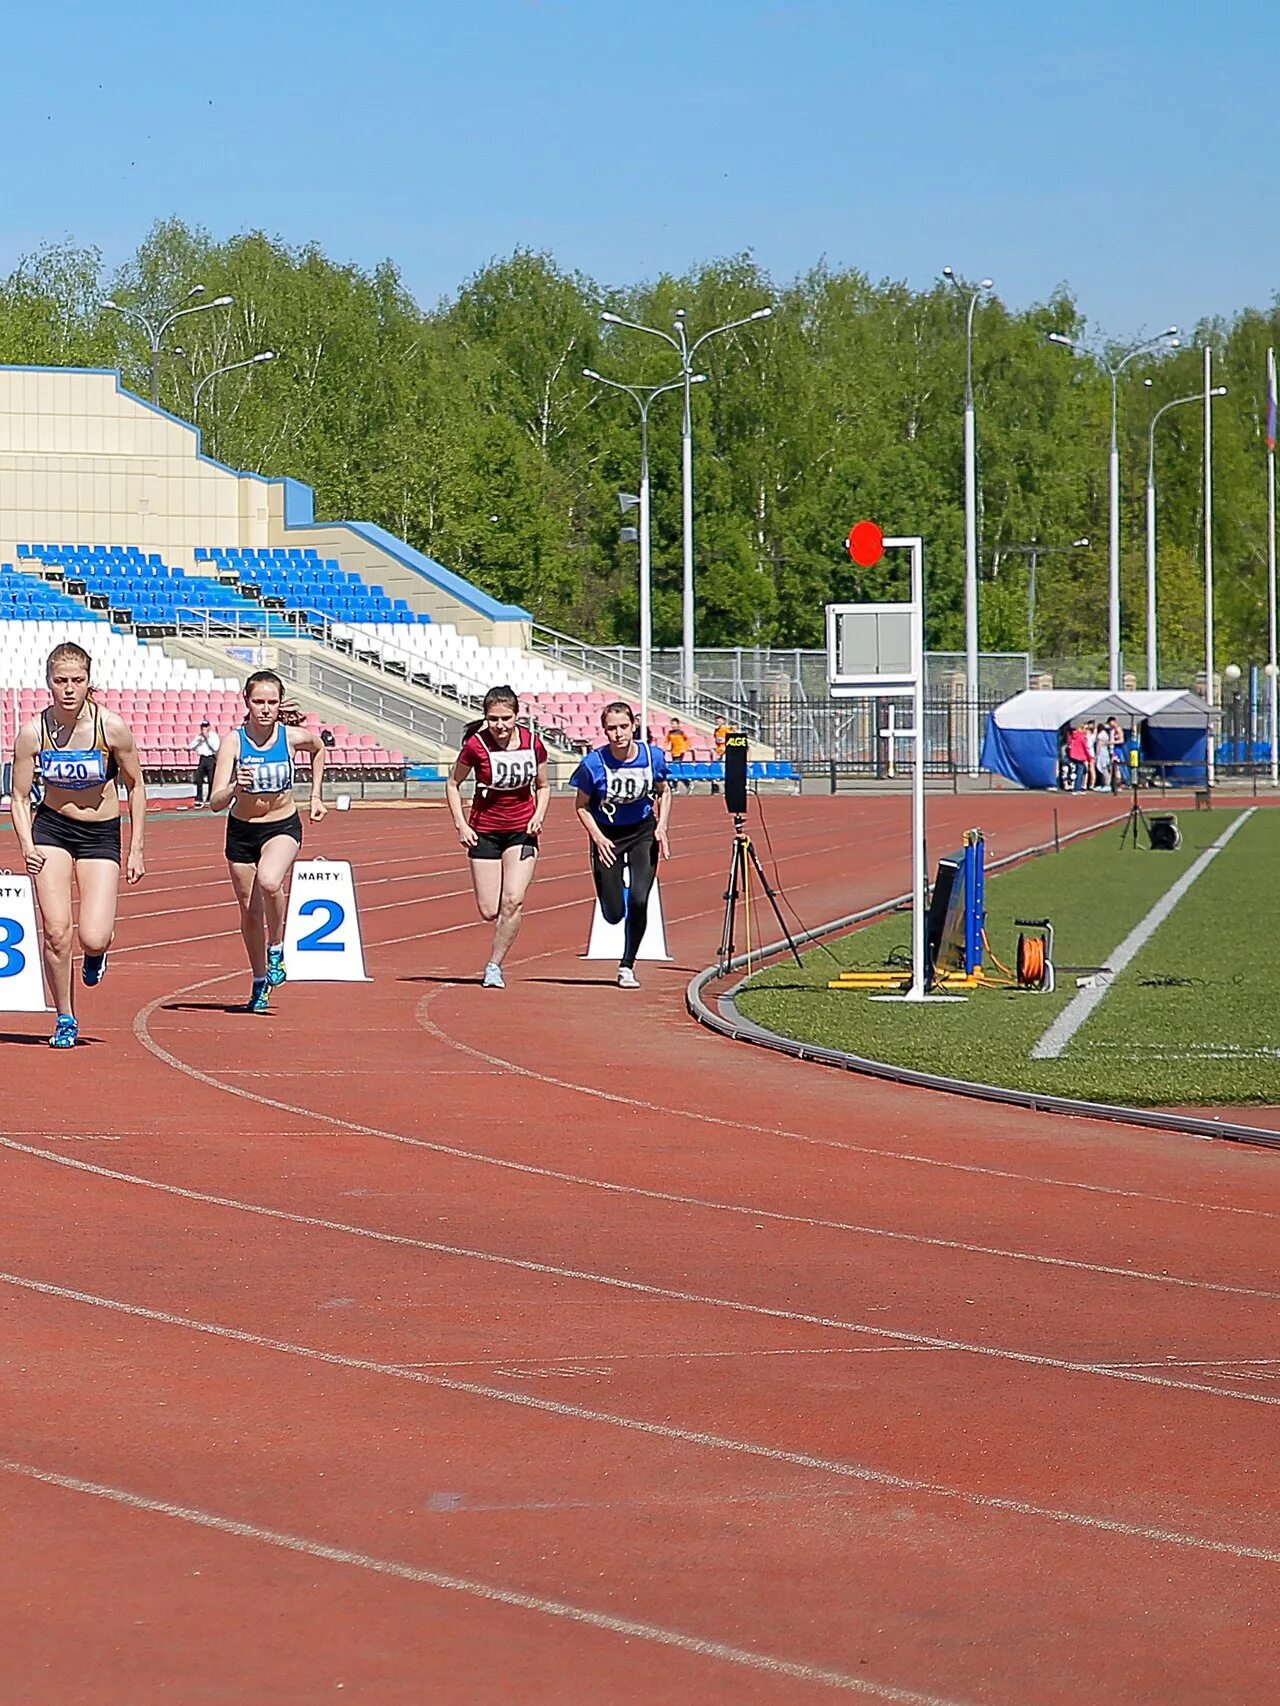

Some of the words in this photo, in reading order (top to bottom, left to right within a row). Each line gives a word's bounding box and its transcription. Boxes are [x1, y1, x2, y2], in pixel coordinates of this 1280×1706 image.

[54, 764, 88, 779] 120
[494, 761, 533, 788] 266
[298, 872, 340, 880] MARTY
[297, 899, 345, 952] 2
